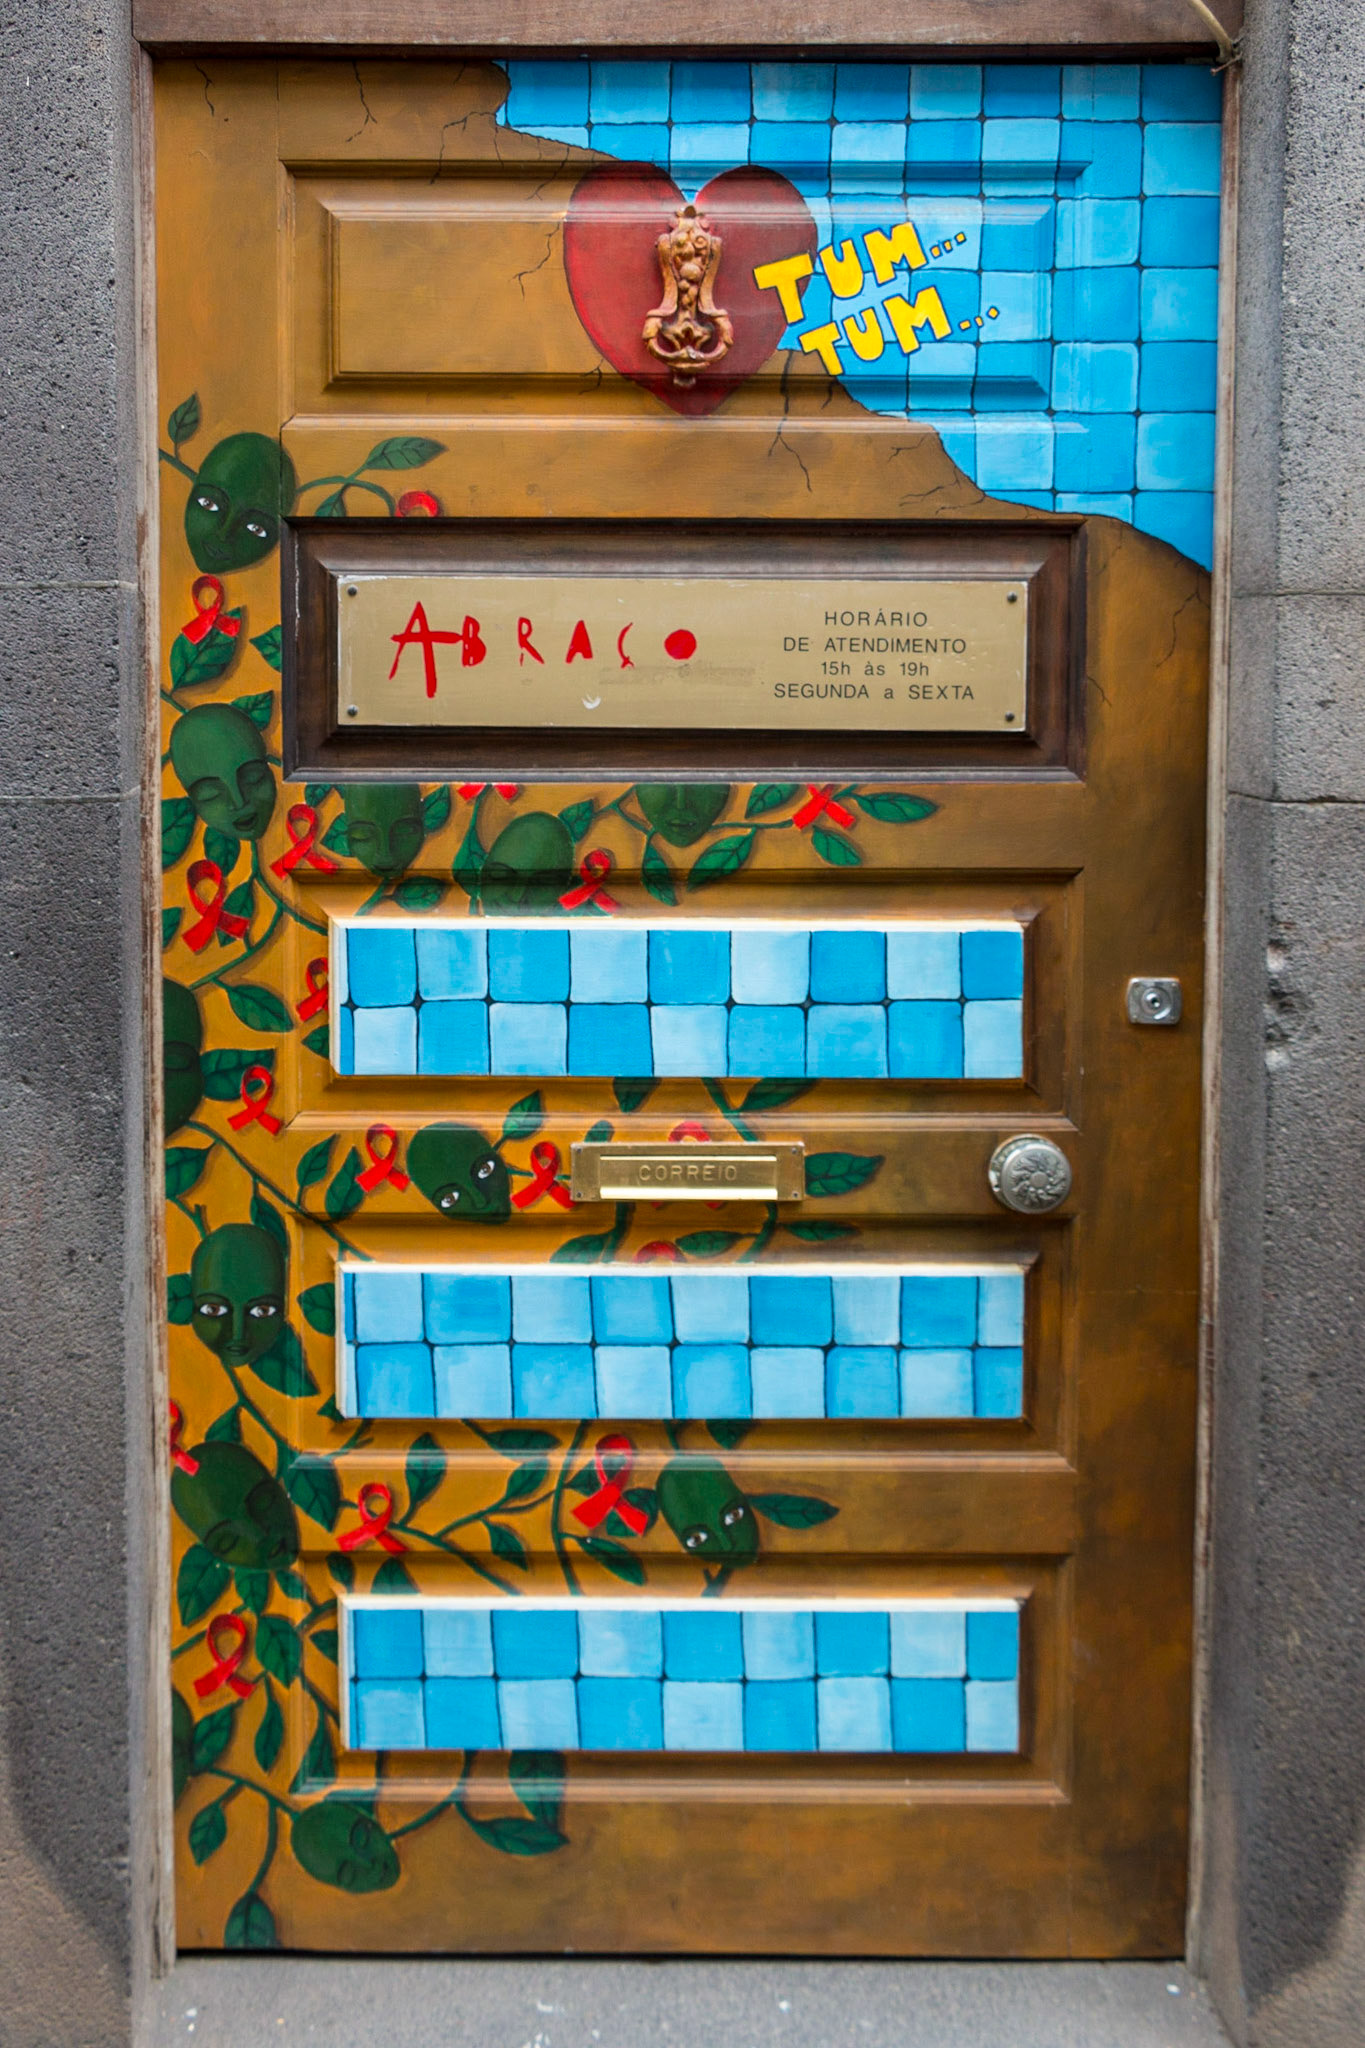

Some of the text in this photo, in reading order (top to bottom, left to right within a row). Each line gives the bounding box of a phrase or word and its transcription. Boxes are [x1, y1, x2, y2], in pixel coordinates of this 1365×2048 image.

[823, 607, 929, 628] HORÁRIO
[783, 636, 967, 655] DE ATENDIMENTO
[819, 660, 930, 677] 15h às 19h
[773, 682, 976, 701] SEGUNDA a SEXTA
[638, 1164, 739, 1182] CORREIO
